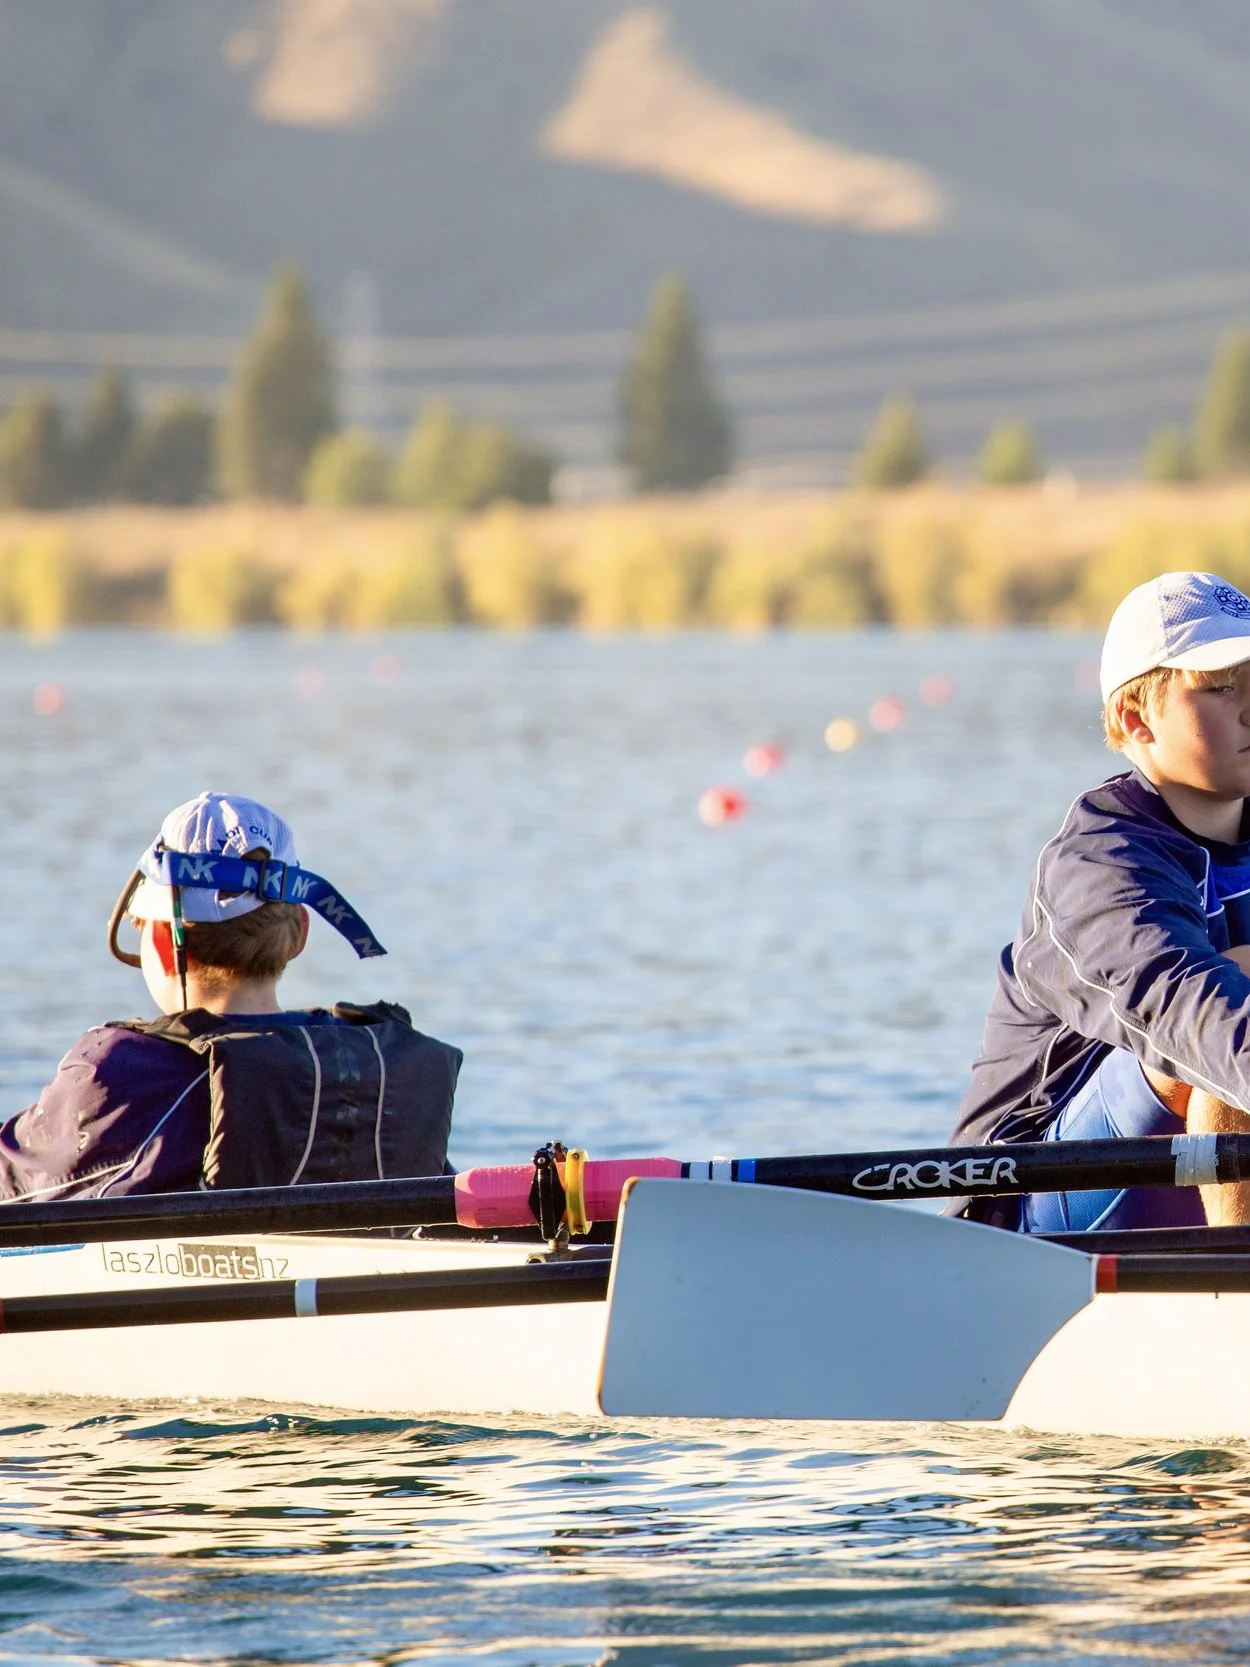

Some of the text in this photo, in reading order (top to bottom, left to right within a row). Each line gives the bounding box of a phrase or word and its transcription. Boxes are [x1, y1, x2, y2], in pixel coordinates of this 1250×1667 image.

[178, 858, 219, 883] NK
[291, 875, 318, 899] NK
[317, 895, 354, 924] NK
[852, 1157, 1019, 1191] CROKER
